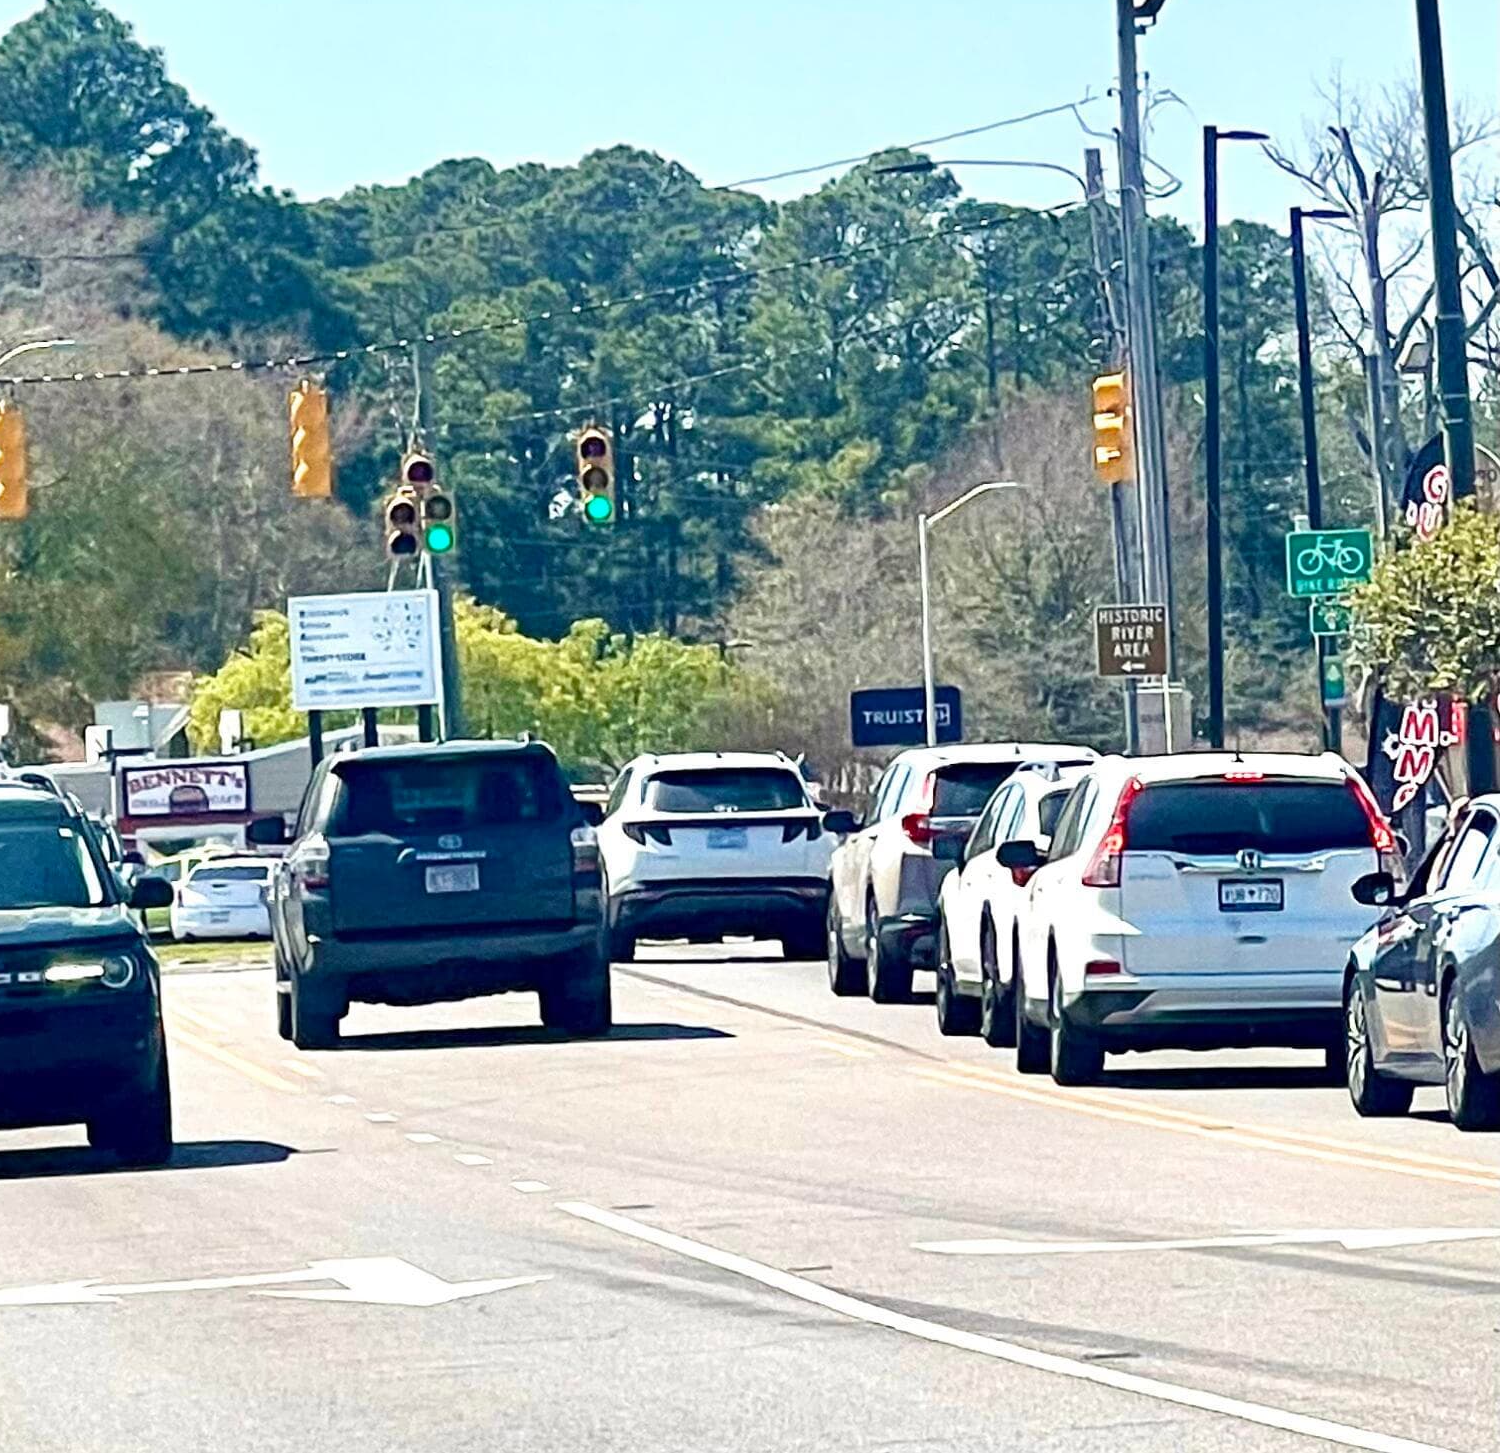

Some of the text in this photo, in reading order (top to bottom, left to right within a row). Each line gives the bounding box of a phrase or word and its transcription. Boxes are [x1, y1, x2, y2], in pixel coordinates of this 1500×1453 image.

[1099, 609, 1163, 624] HISTORIC
[1111, 625, 1154, 641] RIVER
[1113, 642, 1151, 657] AREA
[862, 709, 924, 724] TRUIST
